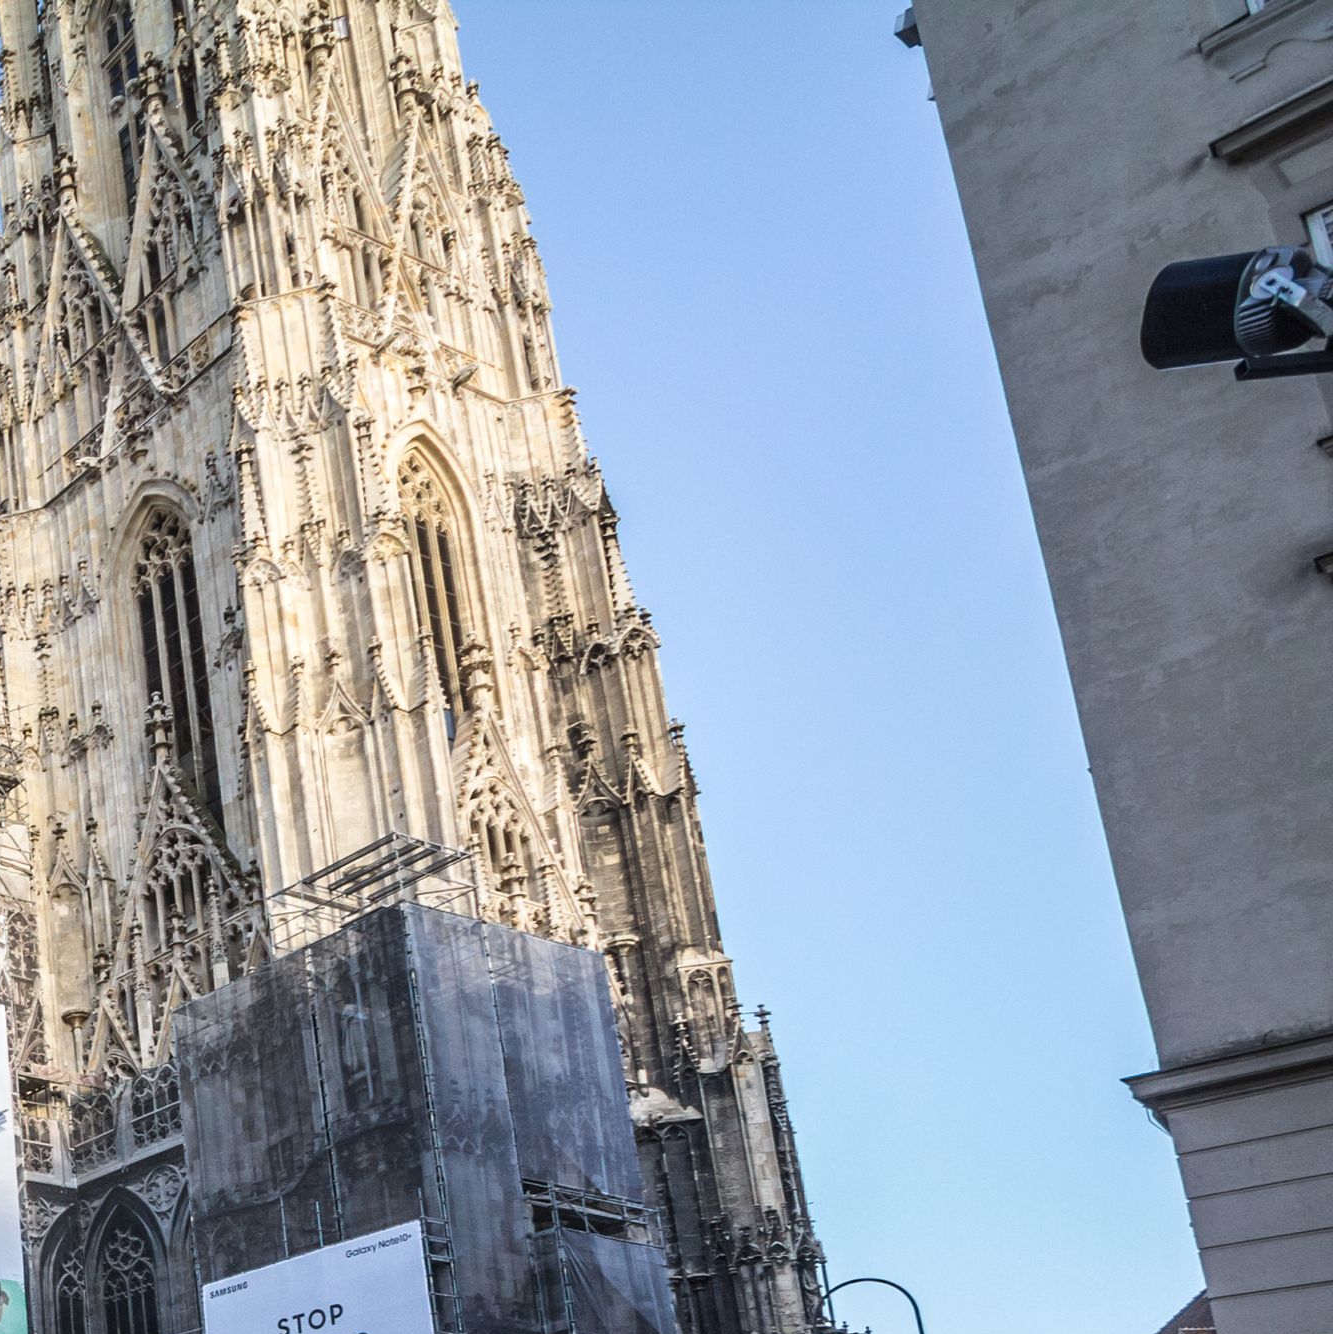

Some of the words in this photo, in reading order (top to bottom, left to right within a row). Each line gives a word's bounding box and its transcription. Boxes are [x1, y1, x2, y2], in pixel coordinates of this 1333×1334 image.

[345, 1243, 377, 1259] Galaxy
[377, 1233, 412, 1249] Note10+
[210, 1281, 249, 1299] SAMSUNG
